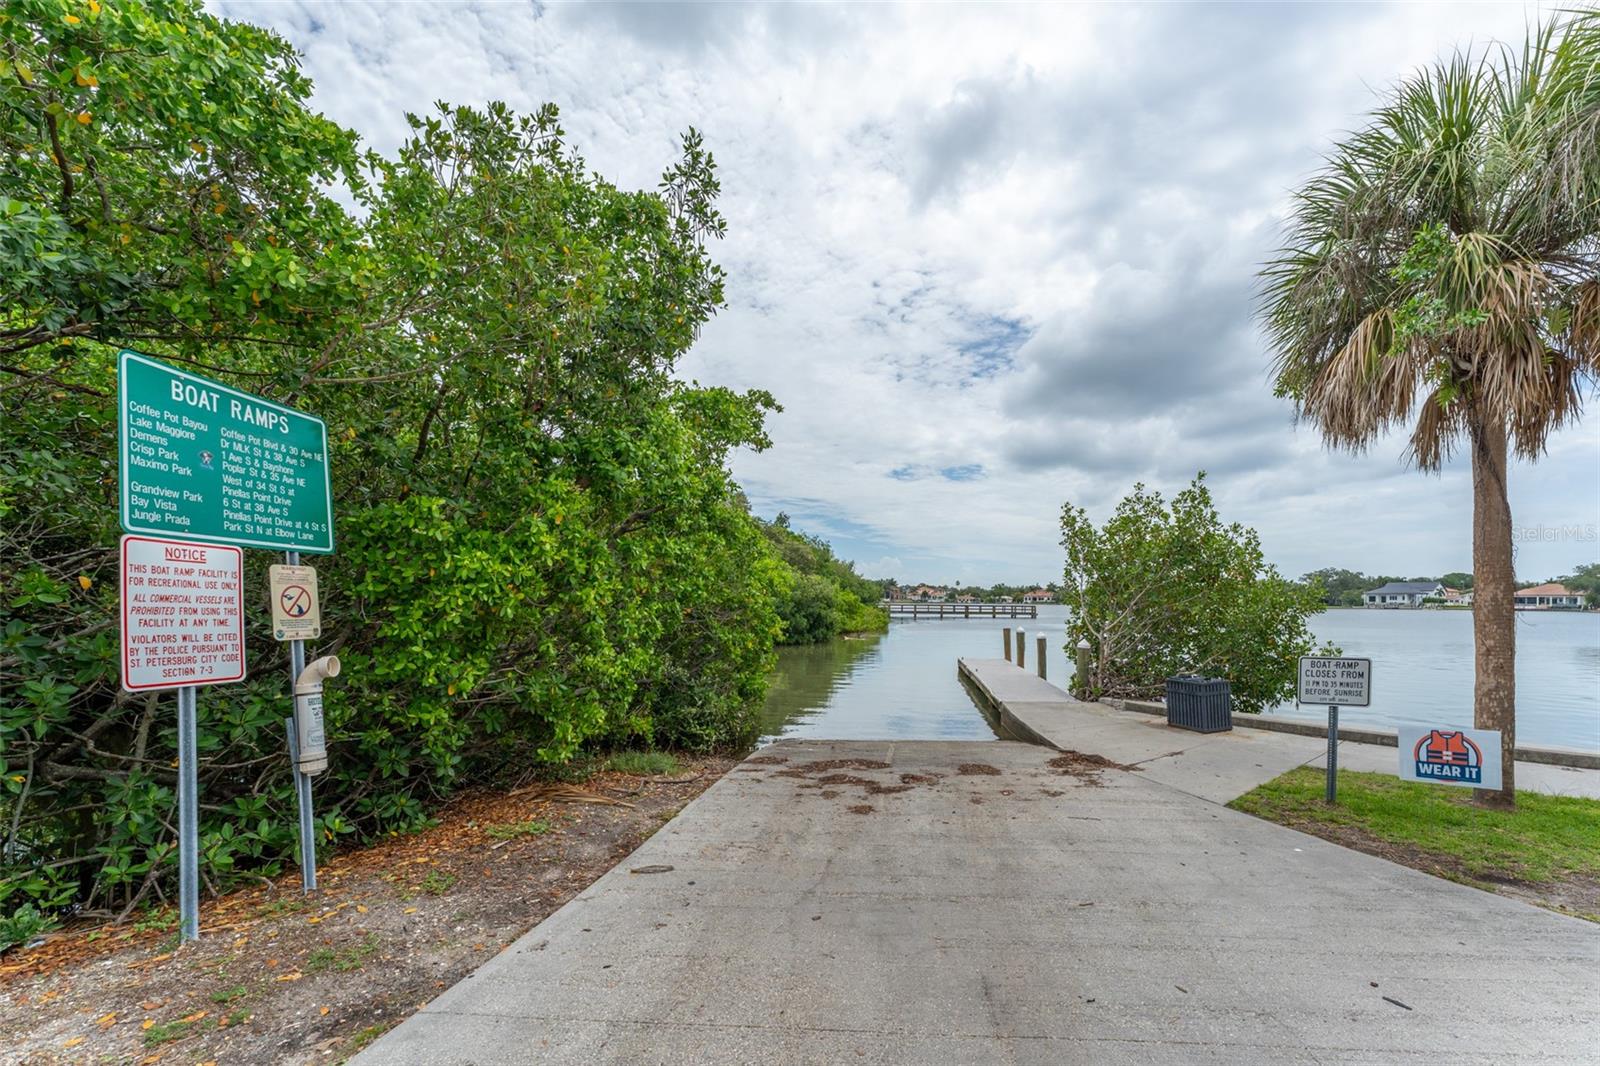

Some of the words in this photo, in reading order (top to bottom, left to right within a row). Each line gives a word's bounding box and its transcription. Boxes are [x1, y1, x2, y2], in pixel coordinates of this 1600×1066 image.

[130, 401, 160, 418] Coffee
[164, 411, 178, 423] Pot
[182, 416, 208, 431] Bayou
[171, 380, 220, 412] BOAT
[231, 400, 289, 434] RAMPS
[130, 414, 152, 428] Lake
[156, 421, 195, 440] Maggiore
[130, 428, 168, 446] Demens
[221, 427, 246, 441] Coffee
[248, 435, 260, 446] Pot
[264, 439, 278, 451] Blvd
[289, 446, 298, 455] 30
[301, 450, 312, 459] Ave
[314, 453, 322, 462] NE
[130, 442, 154, 456] Crisp
[159, 448, 179, 461] Park
[221, 439, 230, 448] Dr
[233, 442, 250, 454] MLK
[253, 447, 261, 457] St
[274, 452, 282, 462] 38
[286, 456, 297, 466] Ave
[130, 455, 168, 471] Maximo
[172, 463, 192, 476] Park
[229, 452, 242, 464] Ave
[246, 456, 251, 465] S
[254, 459, 259, 467] &
[263, 460, 294, 475] Bayshore
[222, 461, 245, 474] Poplar
[250, 468, 258, 477] St
[270, 472, 279, 481] 35
[282, 475, 294, 484] Ave
[297, 478, 306, 487] NE
[131, 481, 180, 498] Grandview
[183, 490, 203, 503] Park
[223, 474, 242, 486] West
[246, 480, 253, 488] of
[256, 481, 266, 490] 34
[269, 483, 277, 493] St
[280, 486, 285, 494] S
[131, 495, 149, 508] Bay
[154, 498, 177, 511] Vista
[223, 486, 250, 499] Pinellas
[253, 491, 271, 503] Point
[274, 496, 292, 506] Drive
[223, 498, 228, 507] 6
[232, 499, 240, 509] St
[244, 502, 251, 511] at
[255, 503, 264, 513] 38
[268, 505, 280, 515] Ave
[283, 508, 288, 516] S
[131, 509, 161, 522] Jungle
[165, 513, 190, 525] Prada
[224, 509, 251, 522] Pinellas
[254, 514, 272, 525] Point
[275, 518, 292, 528] Drive
[312, 522, 319, 531] St
[321, 524, 326, 532] S
[224, 521, 241, 532] Park
[245, 524, 253, 534] St
[257, 526, 262, 534] N
[275, 528, 295, 538] Elbow
[298, 531, 314, 540] Lane
[165, 547, 206, 560] NOTICE
[129, 564, 147, 573] THIS
[151, 565, 170, 574] BOAT
[174, 568, 194, 576] RAMP
[199, 569, 228, 579] FACILITY
[129, 577, 144, 586] FOR
[148, 578, 200, 588] RECREATIONAL
[221, 582, 237, 590] ONLY
[134, 594, 146, 602] ALL
[150, 594, 191, 603] COMMERCIAL
[196, 595, 221, 604] VESSELS
[131, 607, 175, 615] PROHIBITED
[139, 619, 174, 627] FACILITY
[179, 618, 188, 627] AT
[213, 618, 229, 627] TIME
[131, 635, 177, 643] VIOLATORS
[181, 634, 199, 642] WILL
[130, 648, 140, 656] BY
[145, 647, 158, 655] THE
[163, 646, 188, 655] POLICE
[192, 644, 228, 653] PURSUANT
[147, 656, 197, 666] PETERSBURG
[201, 655, 217, 663] CITY
[163, 668, 195, 678] SECTION
[200, 666, 213, 674] 7-3
[1305, 670, 1336, 678] CLOSES
[1419, 763, 1461, 777] WEAR
[1465, 767, 1478, 778] IT
